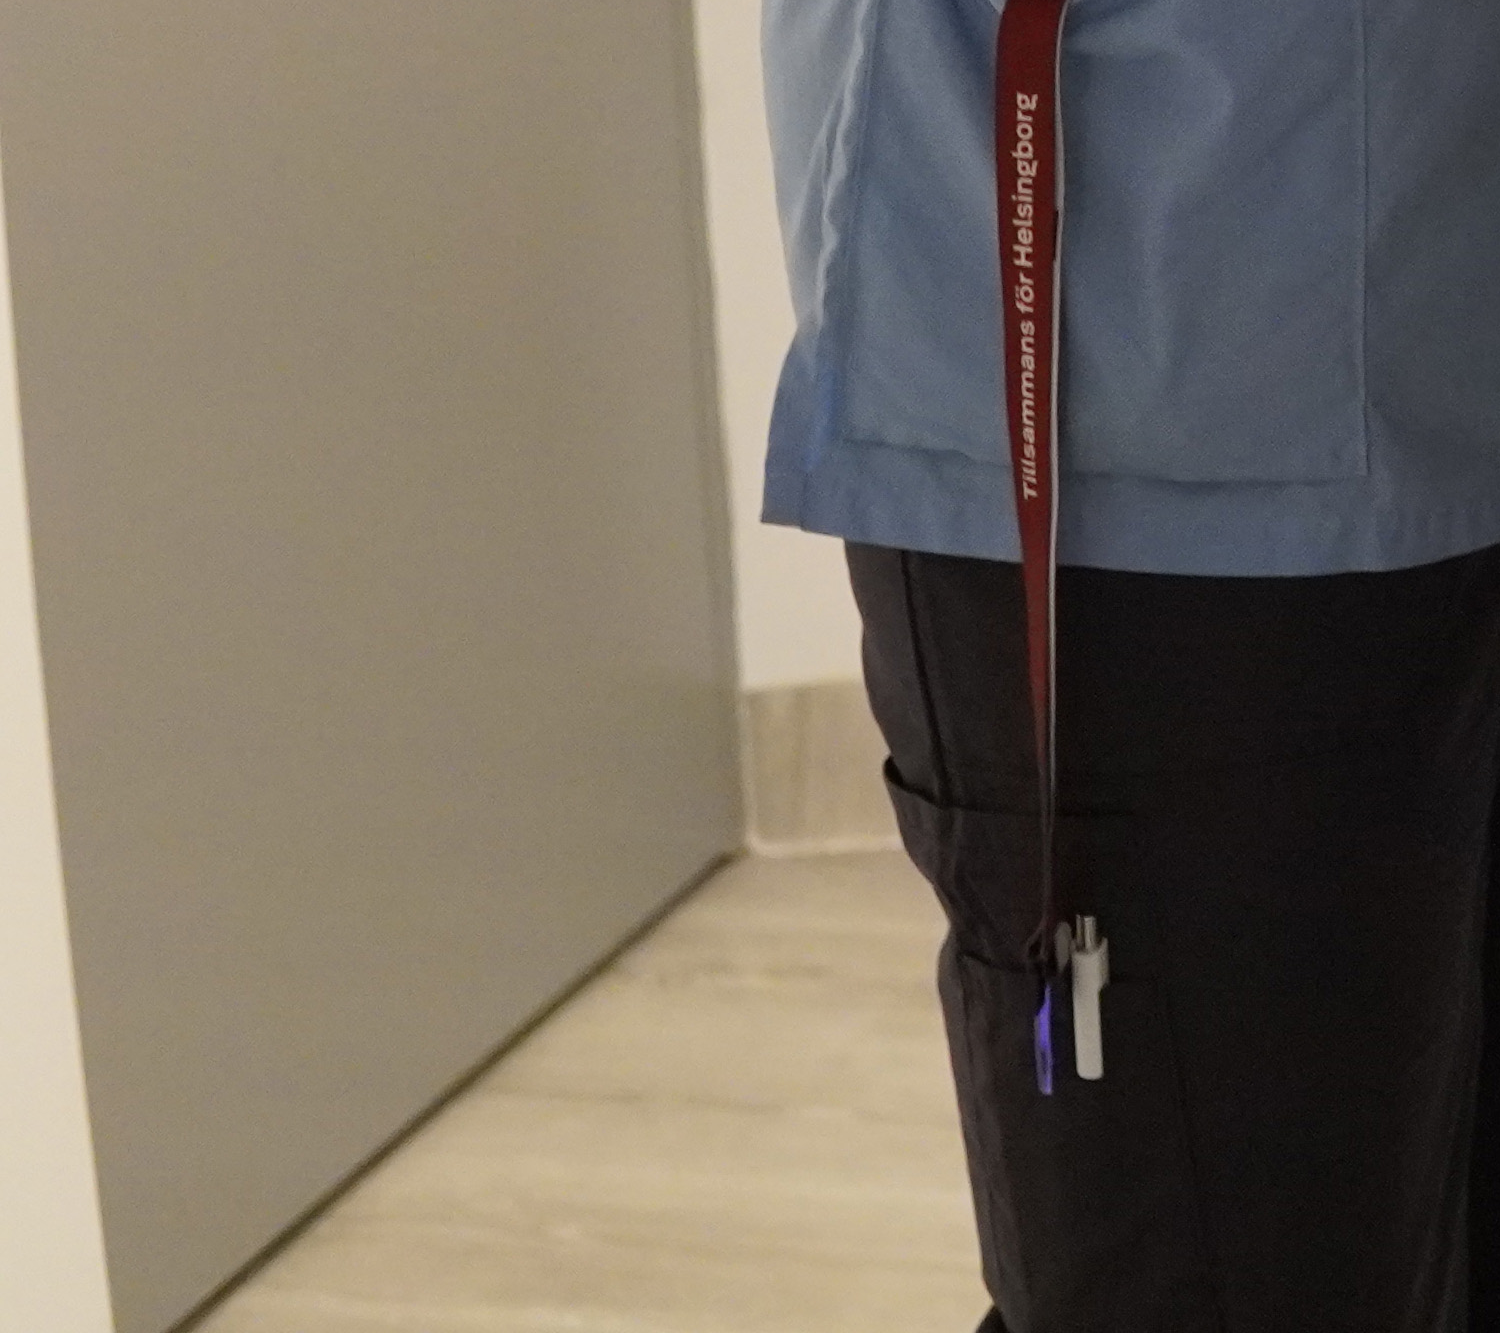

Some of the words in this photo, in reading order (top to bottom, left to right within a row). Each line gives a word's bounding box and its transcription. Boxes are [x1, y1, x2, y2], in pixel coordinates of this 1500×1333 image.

[1011, 90, 1039, 268] Helsingborg
[1016, 271, 1034, 314] för
[1020, 320, 1038, 501] Tillsammans
